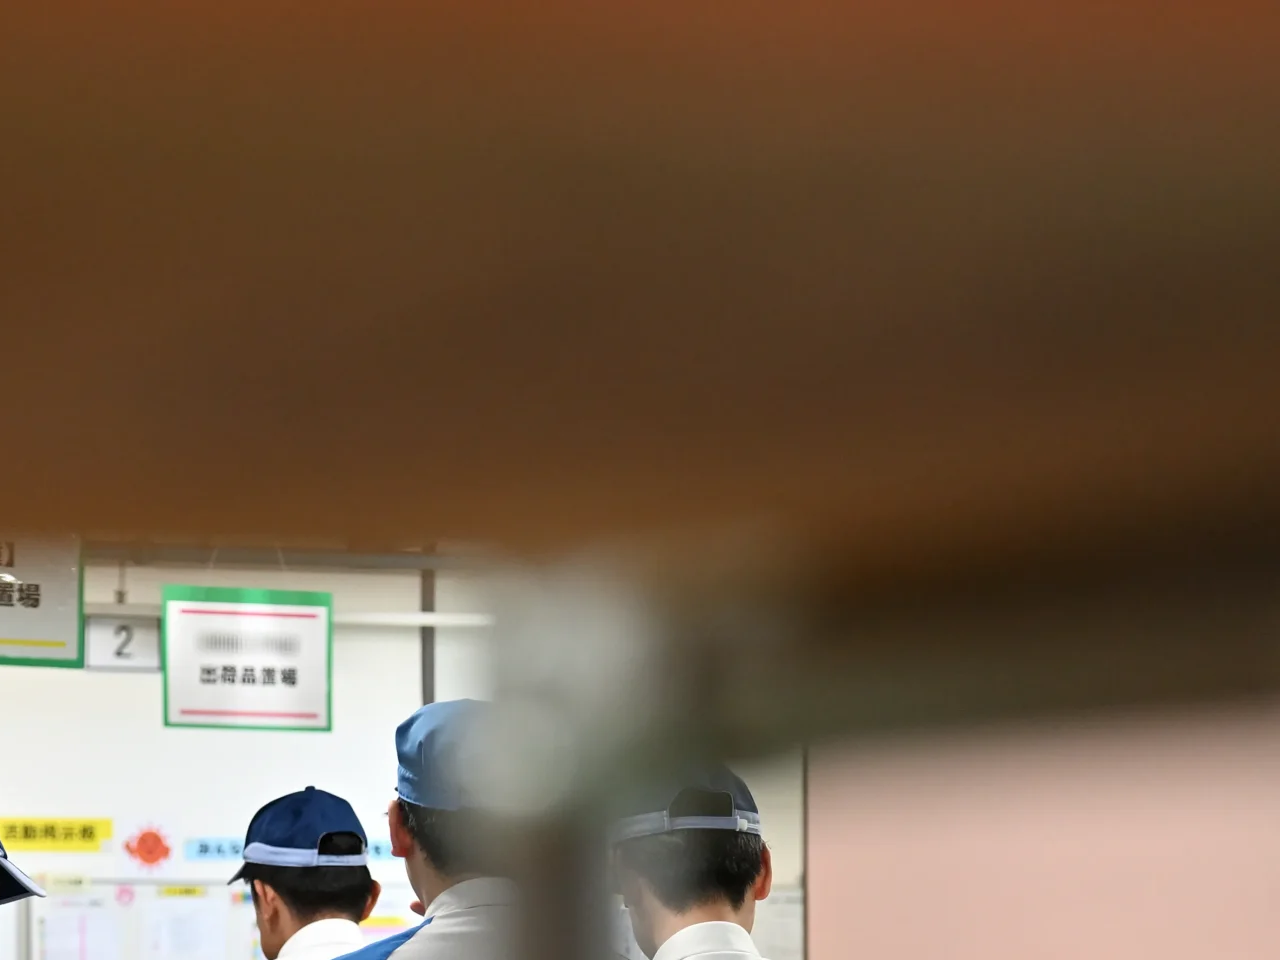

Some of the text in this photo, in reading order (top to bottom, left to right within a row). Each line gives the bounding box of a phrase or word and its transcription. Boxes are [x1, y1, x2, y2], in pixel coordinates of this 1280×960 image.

[113, 624, 134, 659] 2
[199, 665, 298, 687] 出荷品置場
